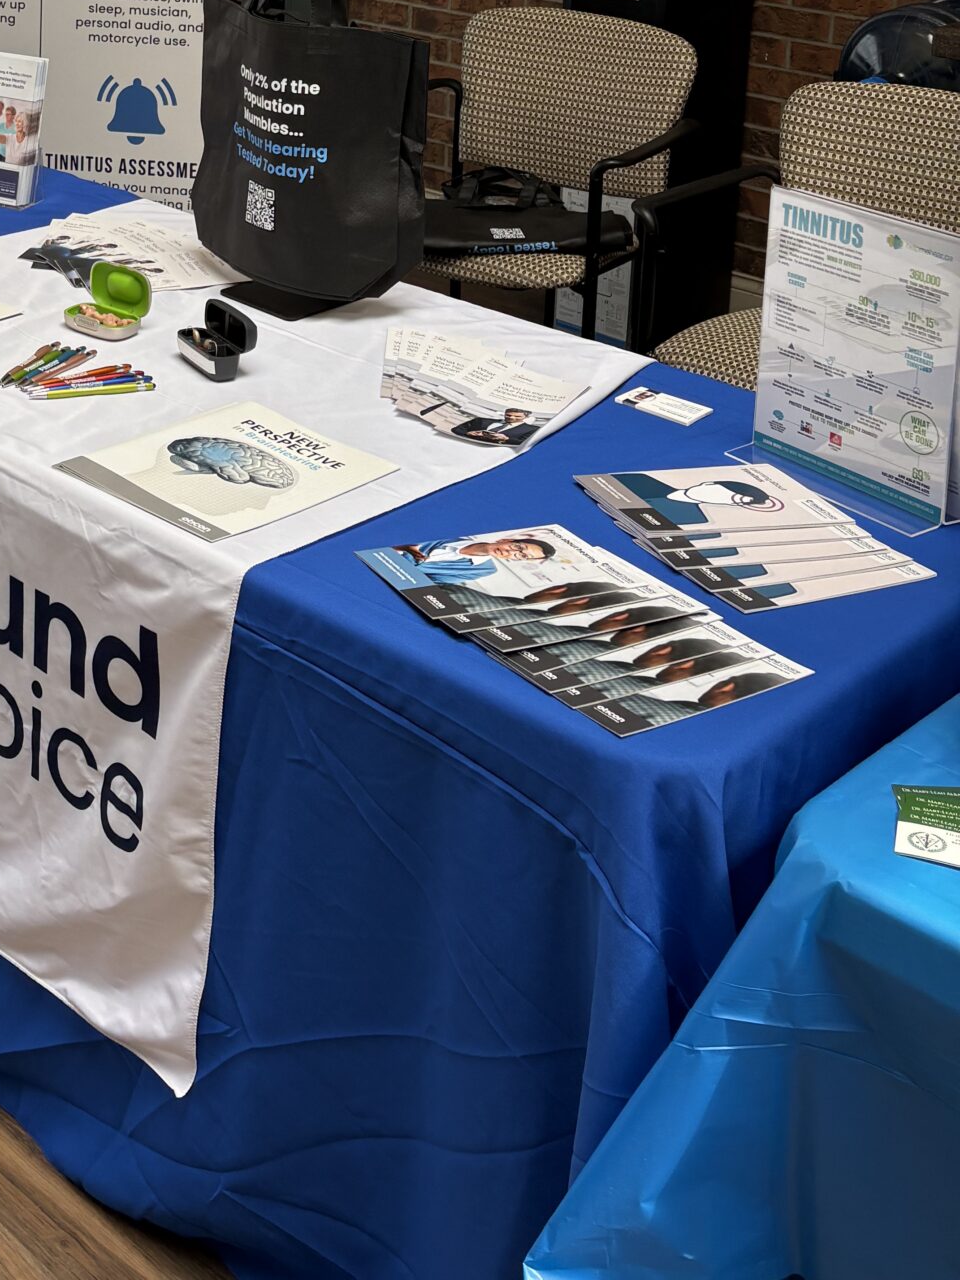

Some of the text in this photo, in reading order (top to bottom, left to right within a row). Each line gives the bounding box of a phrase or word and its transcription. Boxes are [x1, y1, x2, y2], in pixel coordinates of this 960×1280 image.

[10, 2, 26, 13] up
[88, 3, 191, 19] sleep, musician,
[75, 17, 203, 33] personal audio, and
[88, 33, 190, 47] motorcycle use.
[241, 64, 320, 95] Only 2% of the
[244, 87, 305, 115] Population
[234, 121, 328, 162] Get Your Hearing
[45, 153, 197, 179] TINNITUS ASSESSME
[237, 144, 315, 183] Tested Today!
[123, 184, 146, 193] you
[782, 202, 864, 249] TINNITUS
[911, 415, 930, 429] WHAT
[232, 425, 245, 433] in
[245, 432, 320, 471] BrainHearing
[241, 419, 346, 469] PERSPECTIVE
[283, 431, 326, 451] NEW
[904, 430, 934, 449] BE DONE
